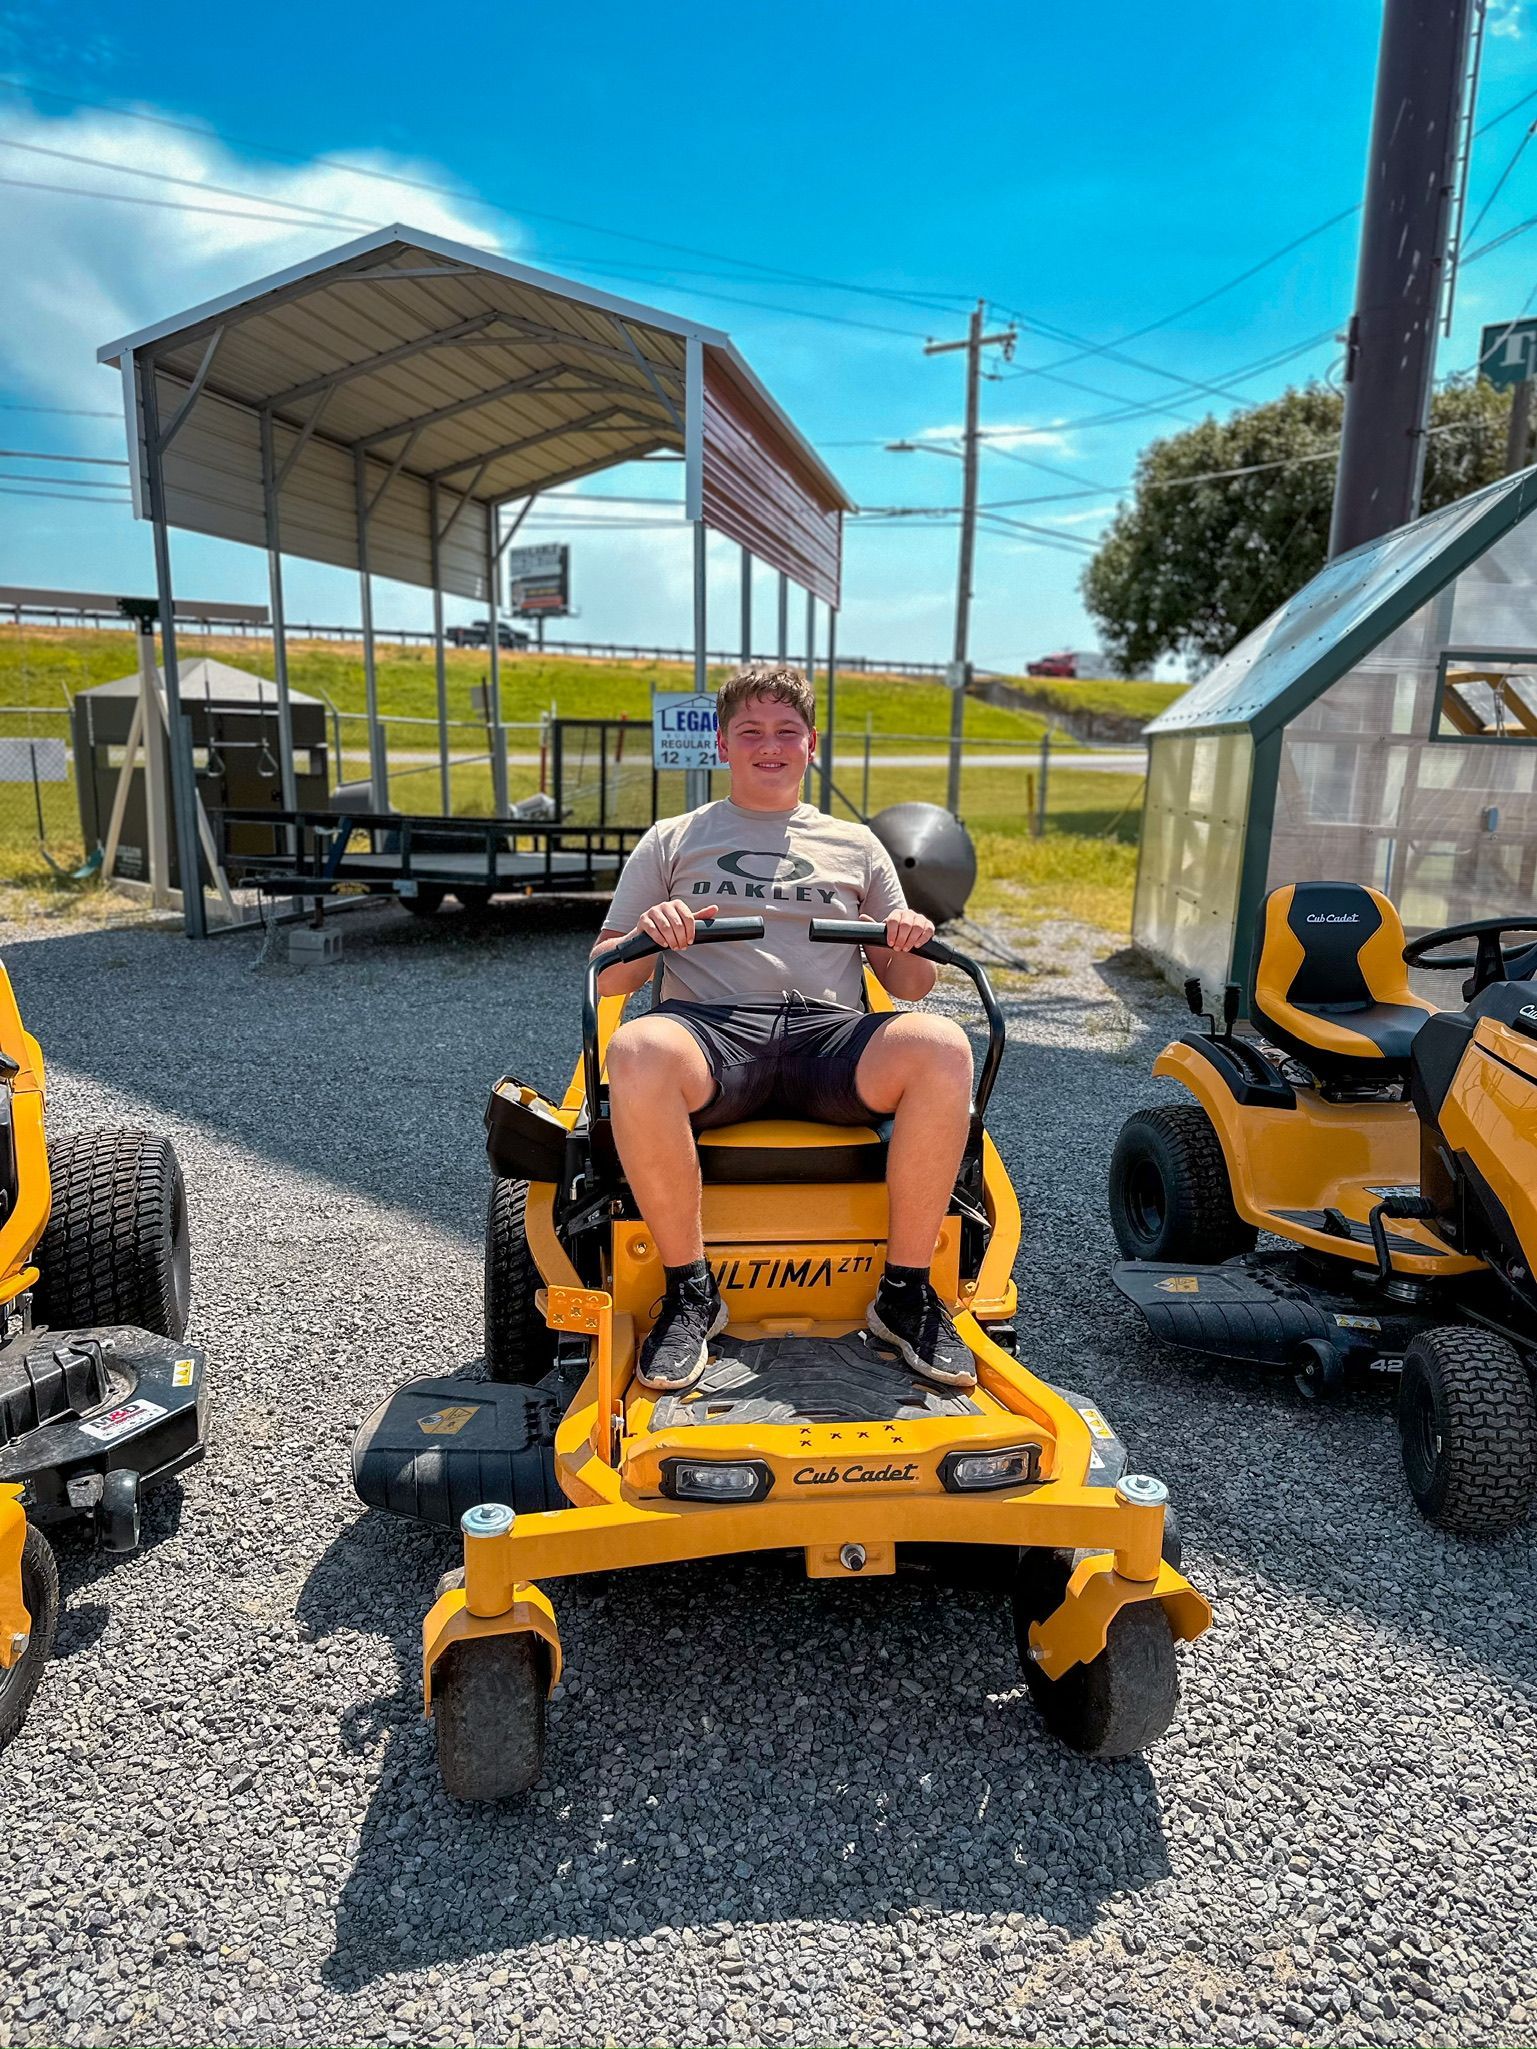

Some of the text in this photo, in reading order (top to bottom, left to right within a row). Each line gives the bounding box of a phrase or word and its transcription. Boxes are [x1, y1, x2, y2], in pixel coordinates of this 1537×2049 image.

[661, 739, 711, 749] REGULAR
[661, 751, 679, 764] 12
[699, 752, 717, 766] 21
[692, 880, 835, 904] OAKLEY
[1306, 913, 1360, 923] Cub Cadet
[837, 1256, 873, 1273] ZT1
[1370, 1359, 1404, 1372] 42
[88, 1404, 141, 1429] M&D
[793, 1466, 840, 1485] Cub
